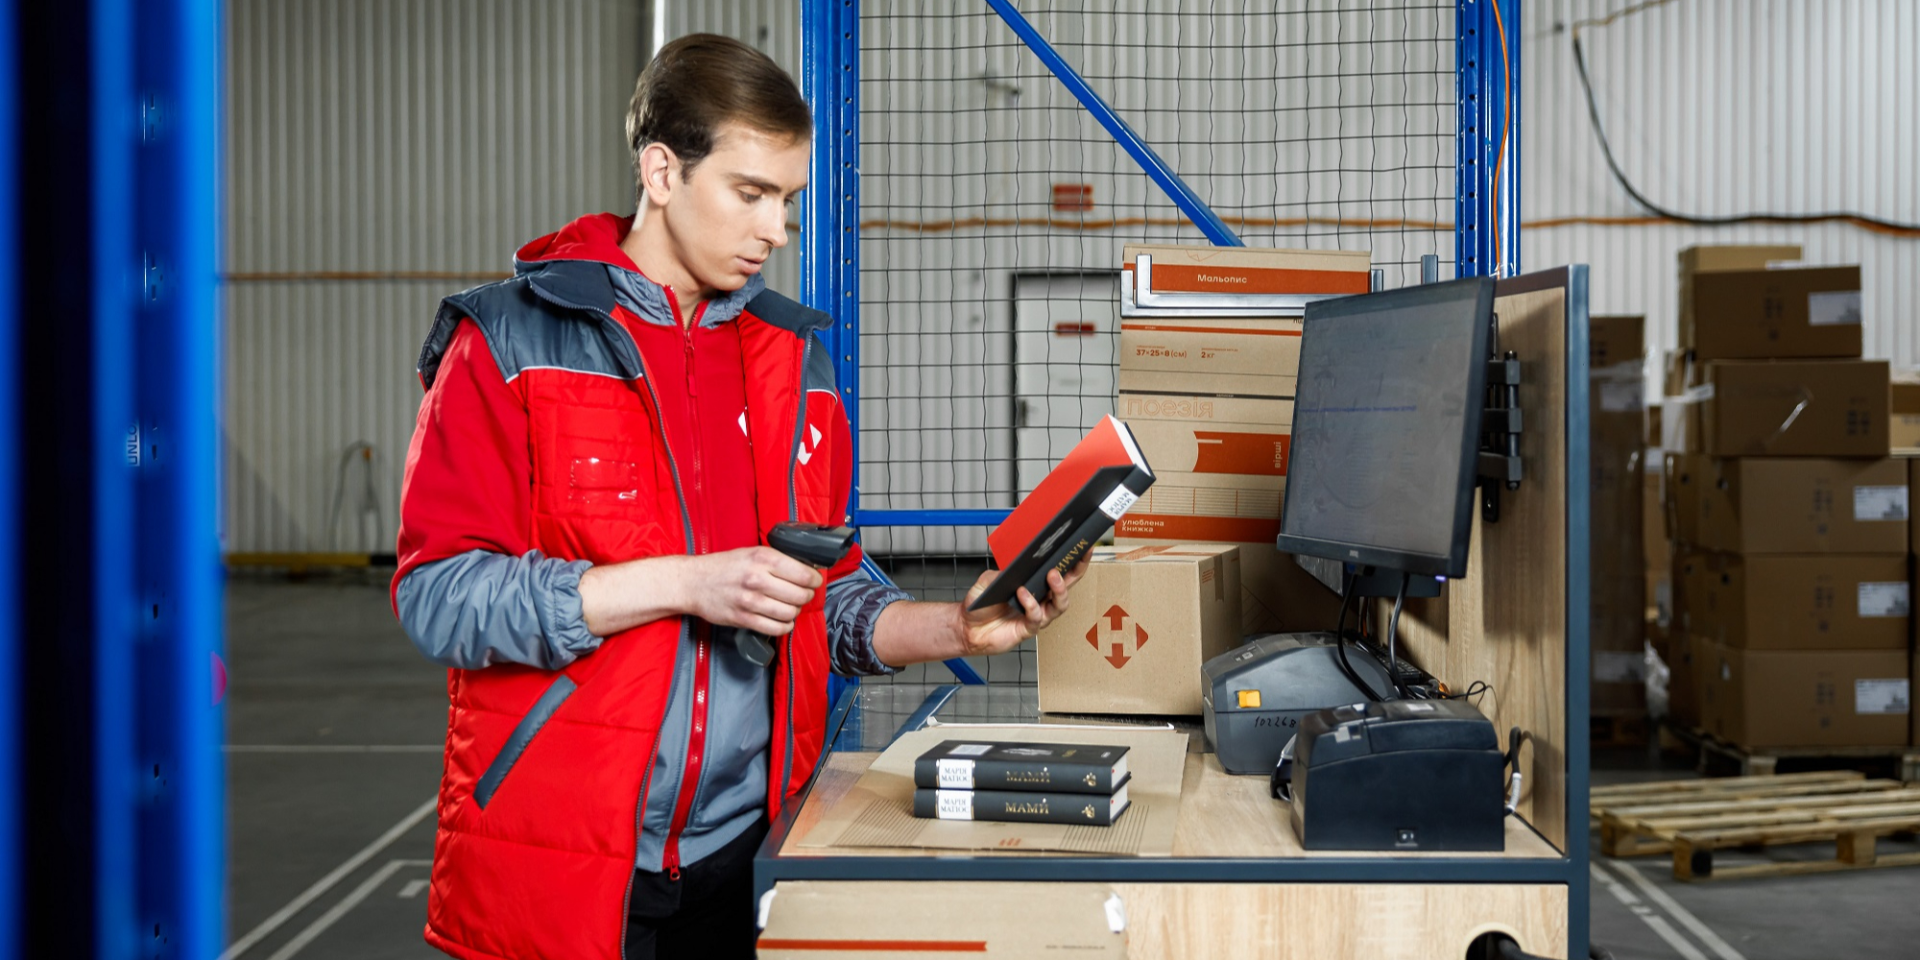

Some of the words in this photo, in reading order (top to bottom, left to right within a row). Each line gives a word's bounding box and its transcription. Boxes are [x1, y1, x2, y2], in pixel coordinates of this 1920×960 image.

[1197, 273, 1248, 284] Мальопис
[1201, 351, 1206, 359] 2
[1127, 397, 1214, 418] поезія
[1274, 441, 1282, 469] вірші
